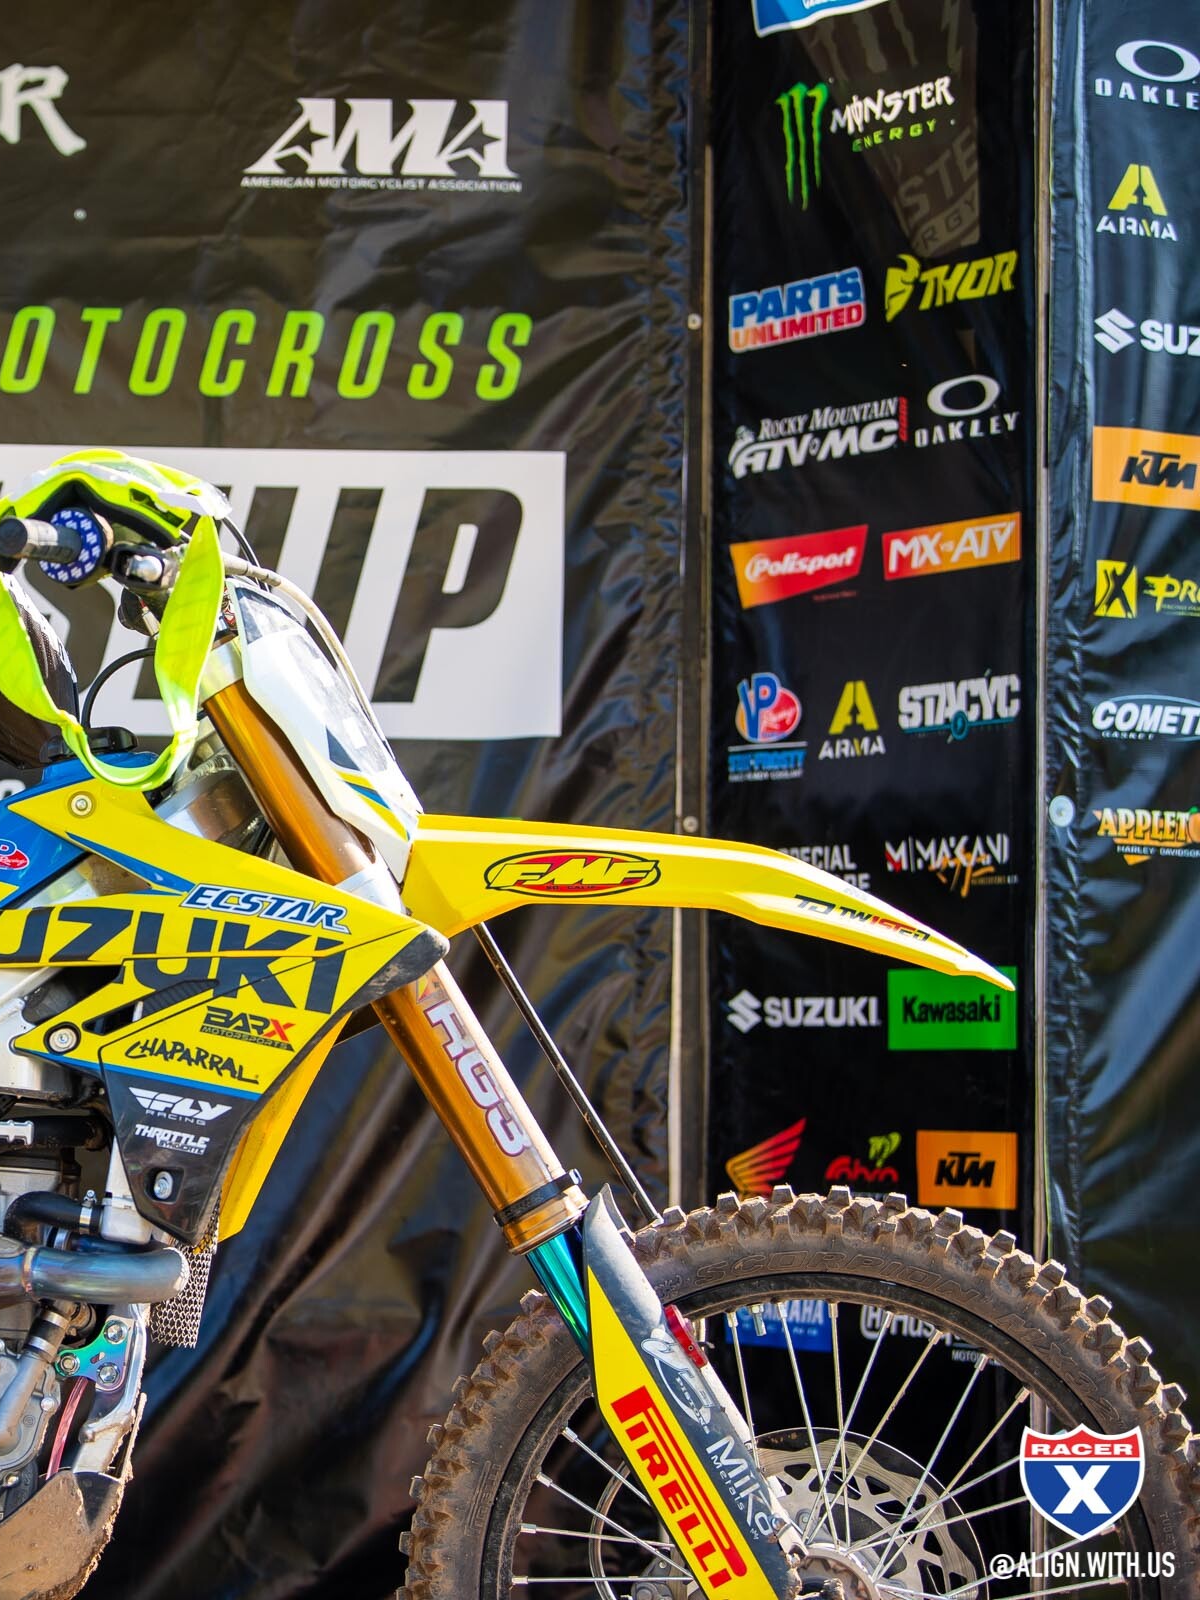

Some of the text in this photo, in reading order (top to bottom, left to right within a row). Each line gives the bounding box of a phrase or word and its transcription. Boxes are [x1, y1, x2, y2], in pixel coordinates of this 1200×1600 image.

[830, 76, 955, 134] MONSTER
[243, 98, 519, 178] AMA
[852, 119, 937, 152] ENERGY
[240, 176, 522, 193] AMERICAN MOTORCYCLIST ASSOCIATION
[1096, 216, 1177, 241] ARMA
[732, 269, 862, 327] PARTS
[919, 251, 1018, 311] THOR
[732, 304, 862, 350] UNLIMITED
[758, 415, 807, 440] ROCKY
[809, 397, 898, 429] MOUNTAIN
[915, 411, 1020, 448] OAKLEY
[1120, 450, 1197, 489] KTM
[744, 546, 857, 582] Polisport
[818, 735, 886, 761] ARMA
[486, 857, 658, 889] FMF
[184, 885, 347, 930] ECSTAR
[203, 1006, 296, 1043] BARX
[764, 996, 880, 1028] SUZUKI
[902, 995, 1001, 1025] Kawasaki
[125, 1037, 260, 1085] CHAPARRAL
[128, 1086, 233, 1121] FLY
[145, 1109, 207, 1126] RACING
[135, 1123, 211, 1148] THROTTLE
[934, 1152, 997, 1188] KTM
[610, 1384, 748, 1589] PIRELLI
